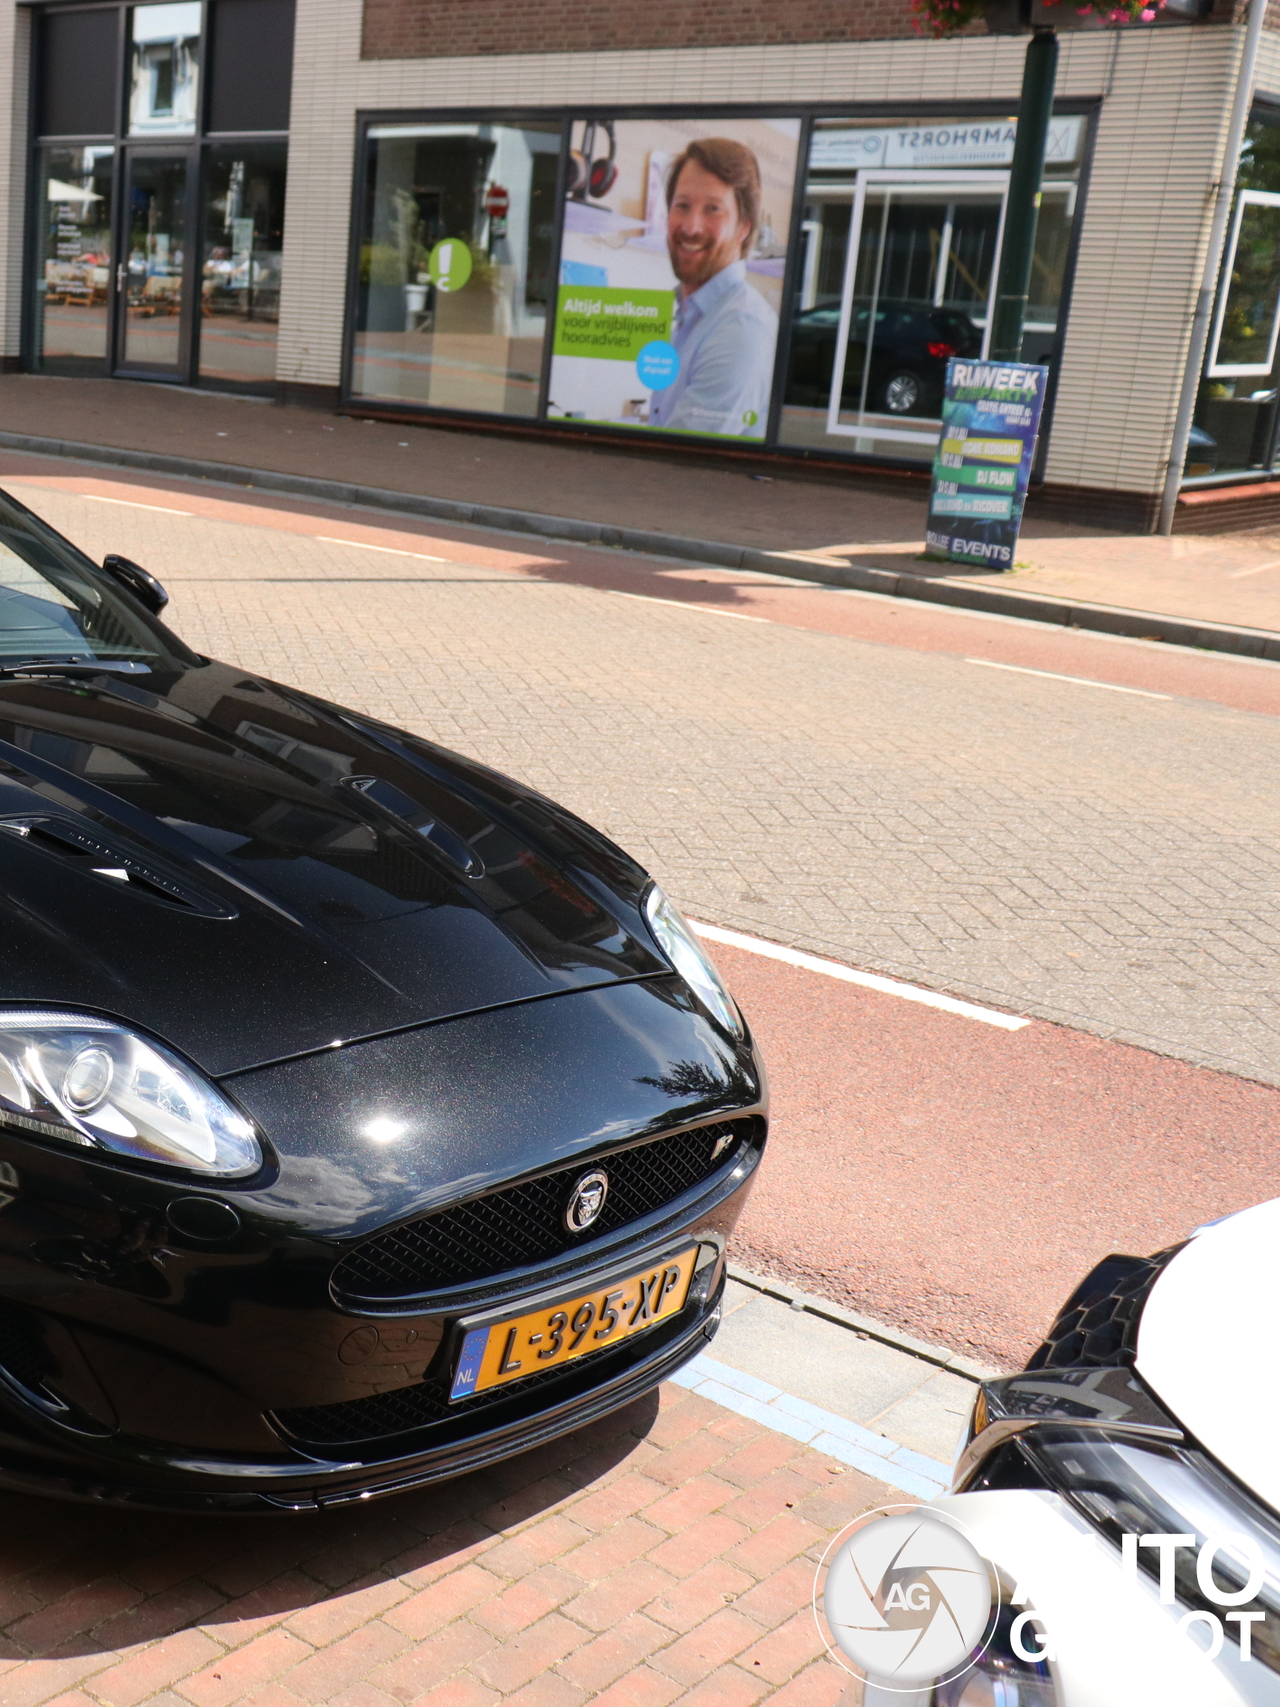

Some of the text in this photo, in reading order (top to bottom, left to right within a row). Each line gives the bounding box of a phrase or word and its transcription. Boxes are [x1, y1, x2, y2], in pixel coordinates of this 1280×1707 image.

[563, 298, 659, 318] Altijd welkom
[563, 317, 667, 335] voor vrijblijvend
[561, 331, 632, 348] hooradvies
[977, 470, 1016, 486] DJ FLOW
[972, 499, 1008, 514] RICOVER
[952, 538, 1011, 561] EVENTS
[456, 1264, 681, 1386] NL L-395-XP
